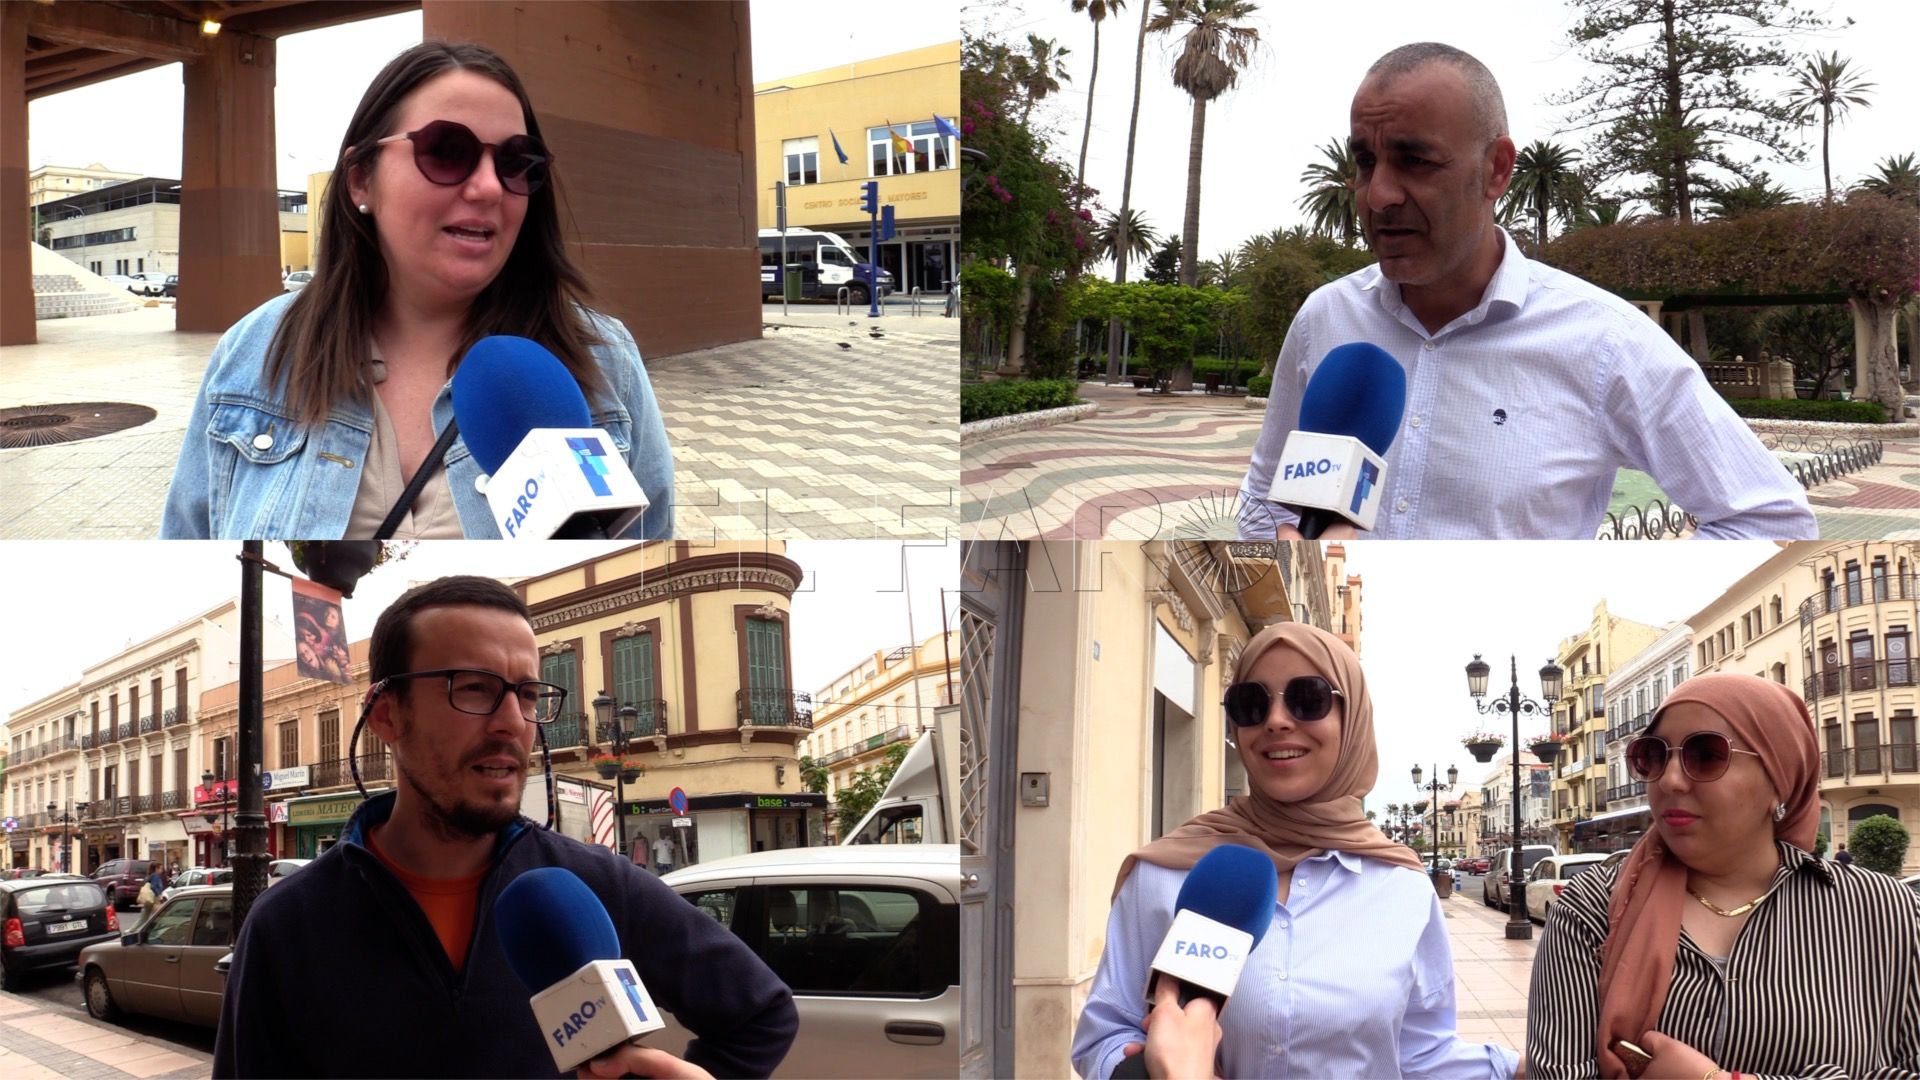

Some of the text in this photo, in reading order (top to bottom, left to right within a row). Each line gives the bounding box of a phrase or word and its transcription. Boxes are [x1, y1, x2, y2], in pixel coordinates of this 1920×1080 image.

[803, 200, 833, 210] CENTRO
[887, 191, 928, 203] MAYORES
[1284, 459, 1331, 481] FARO
[504, 478, 539, 538] FARO
[318, 801, 356, 815] MATEO
[1175, 940, 1228, 960] FARO
[552, 1001, 597, 1047] FARO
